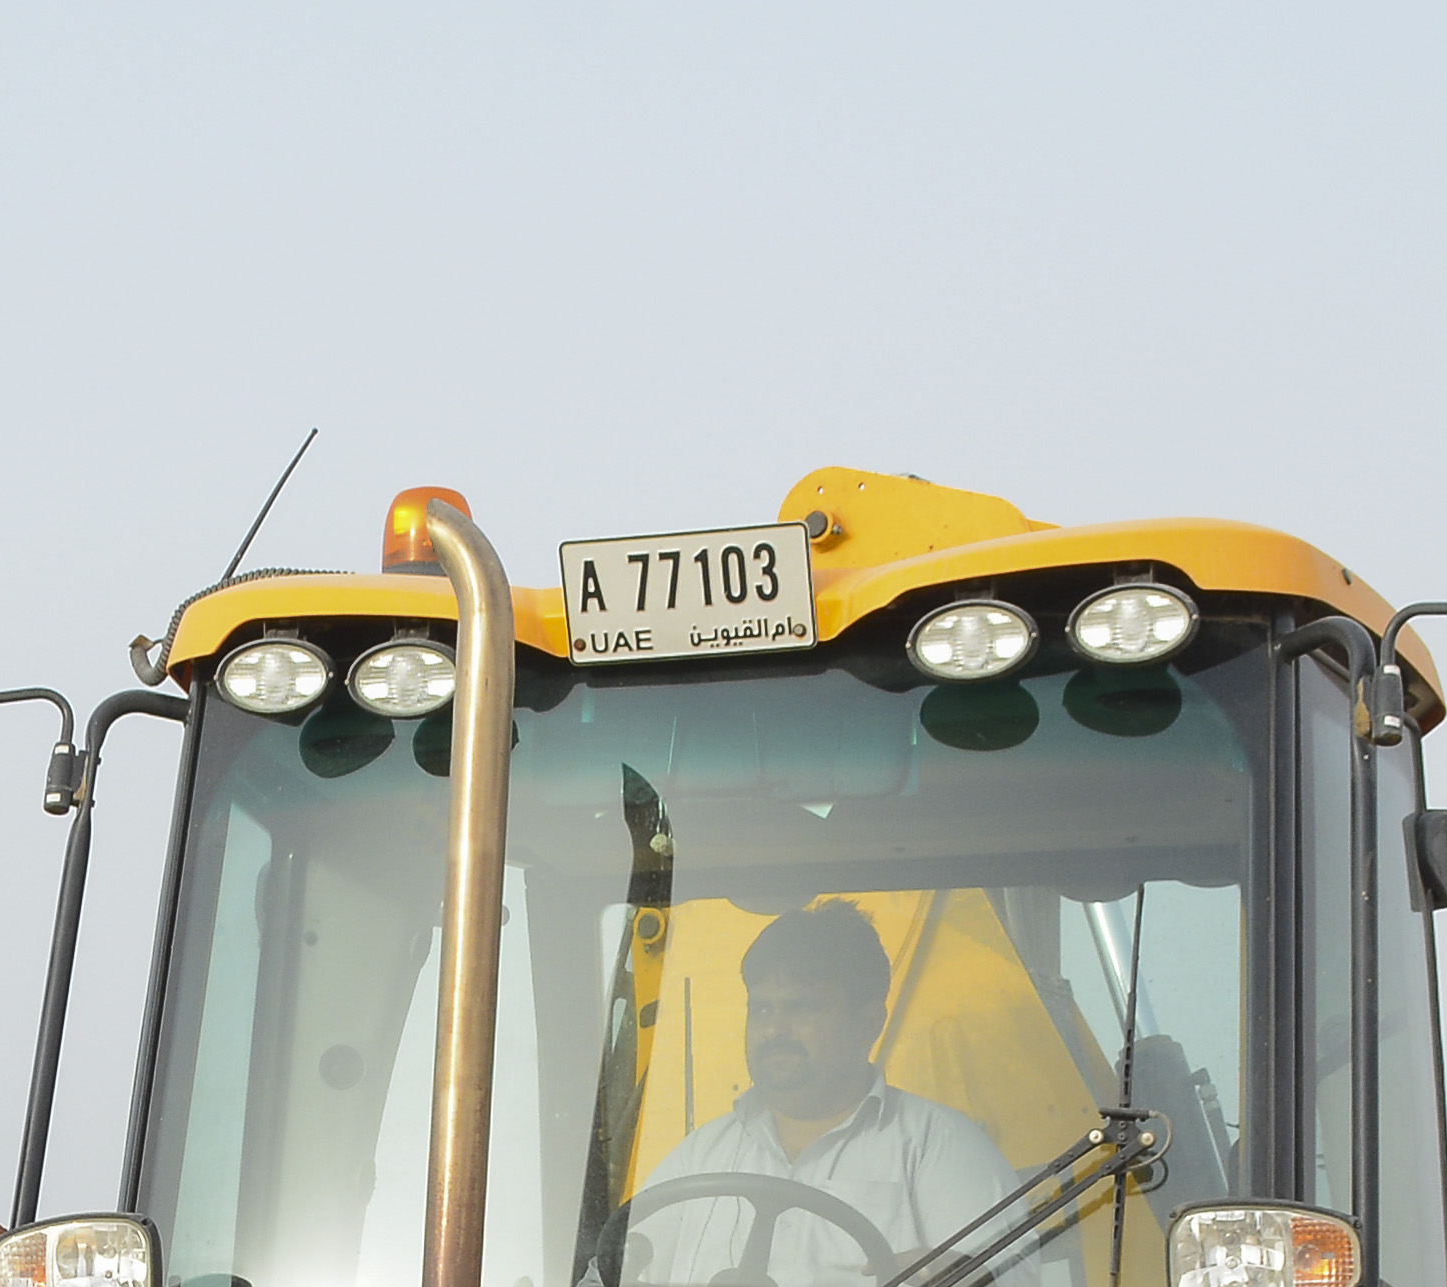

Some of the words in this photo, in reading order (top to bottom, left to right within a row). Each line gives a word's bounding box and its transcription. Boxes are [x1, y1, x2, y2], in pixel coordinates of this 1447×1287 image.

[580, 560, 607, 613] A
[627, 543, 780, 612] 77103
[590, 629, 654, 654] UAE
